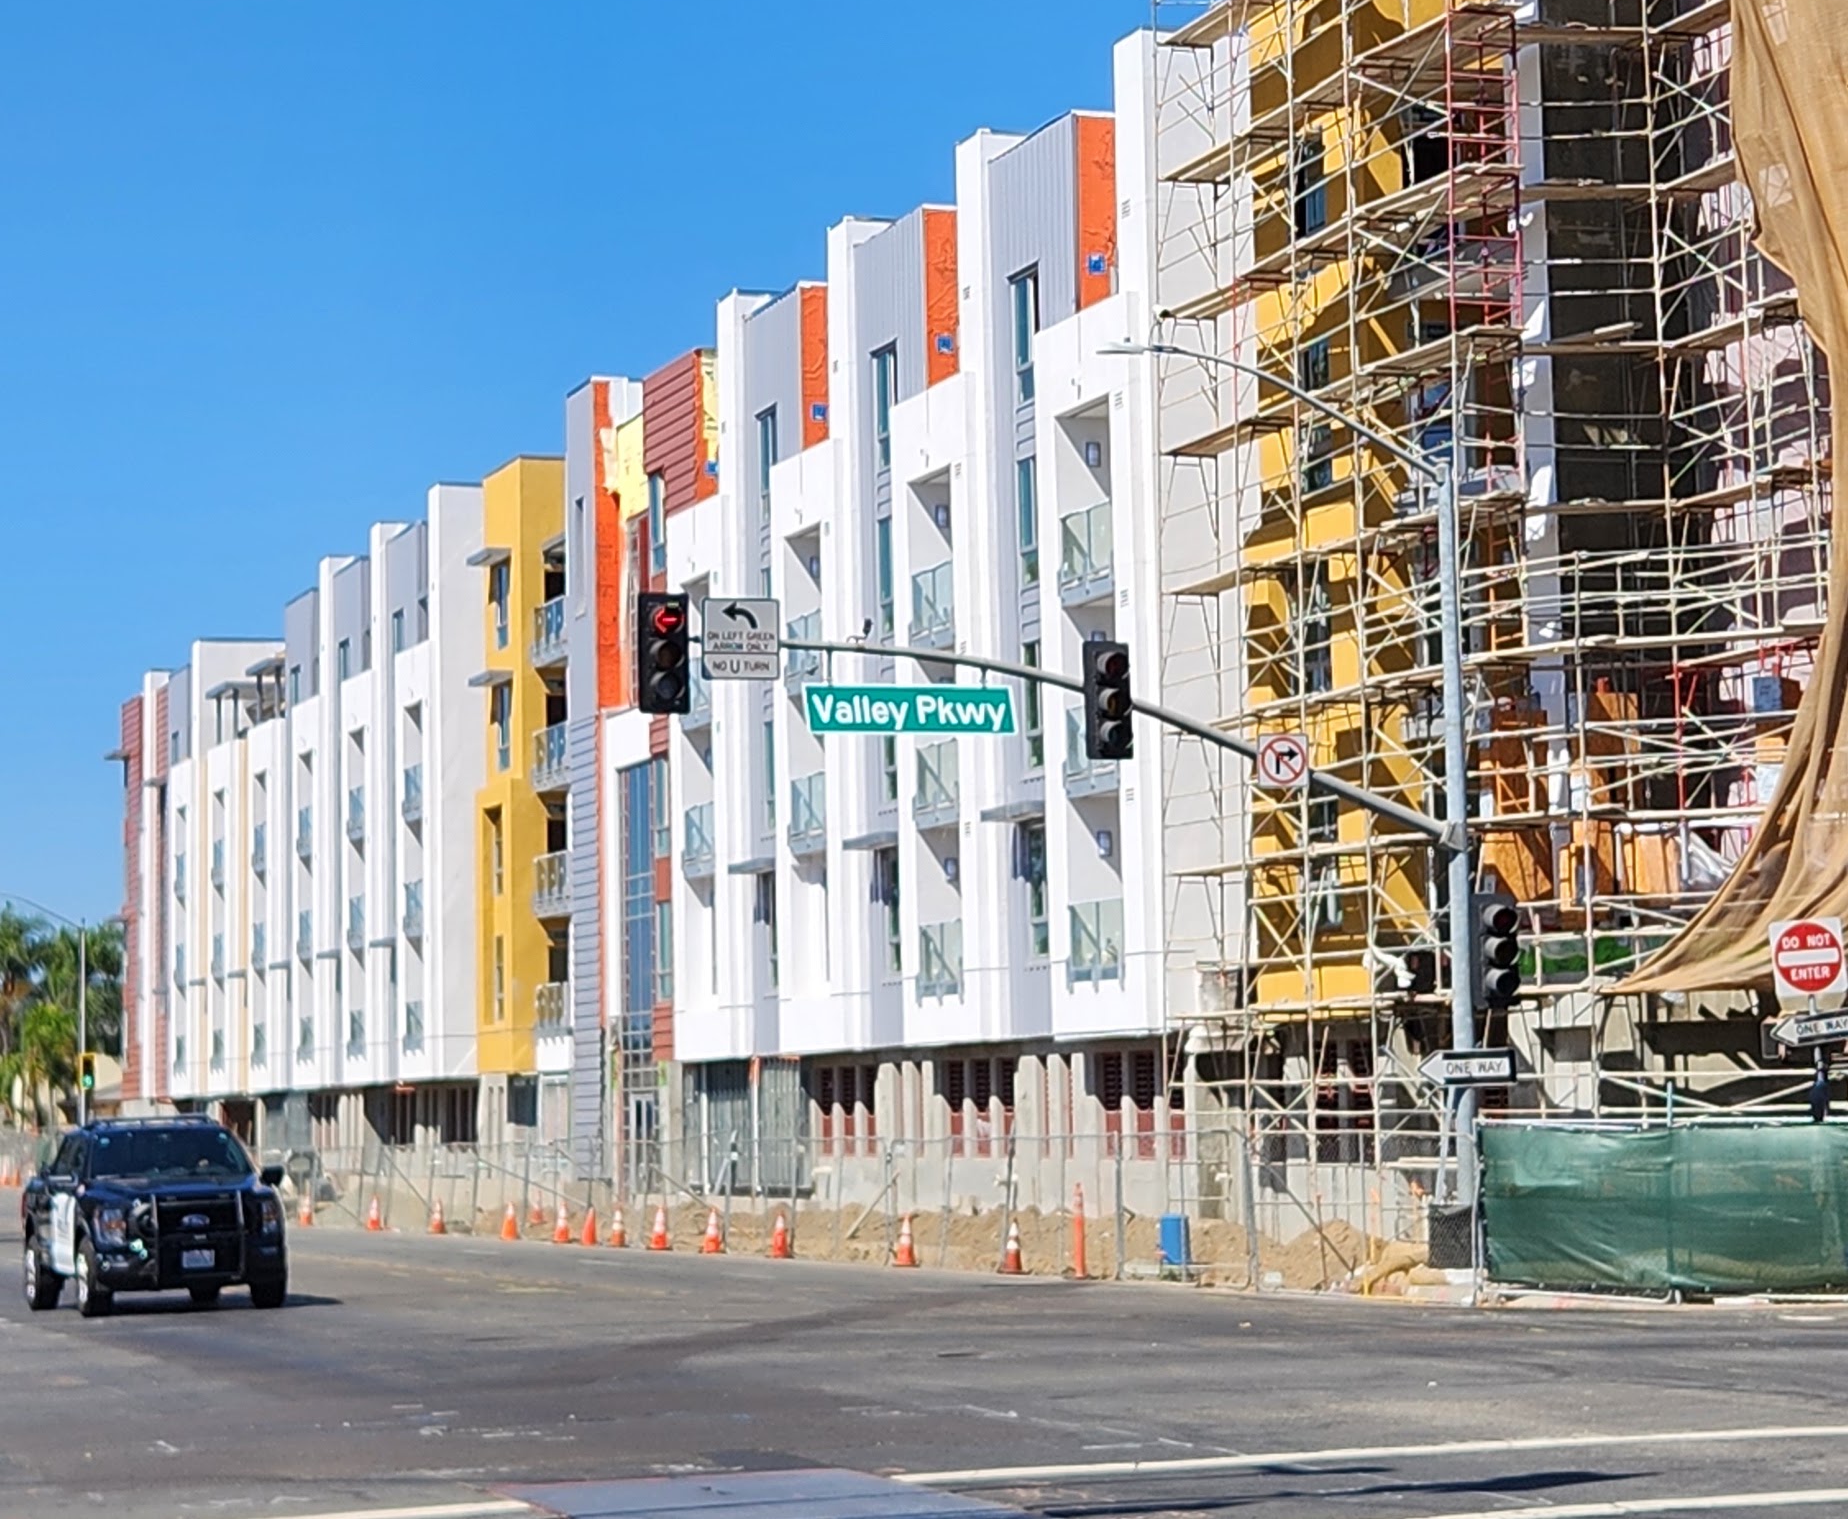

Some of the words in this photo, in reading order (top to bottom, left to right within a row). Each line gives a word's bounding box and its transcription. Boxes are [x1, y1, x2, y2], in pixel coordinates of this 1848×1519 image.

[707, 631, 719, 640] ON
[722, 631, 743, 640] LEFT
[746, 631, 775, 640] GREEN
[746, 642, 769, 651] ONLY
[712, 660, 727, 671] NO
[730, 659, 740, 674] U
[743, 661, 770, 671] TURN
[811, 693, 909, 731] Valley
[915, 694, 1006, 732] Pkwy
[1782, 936, 1799, 949] DO
[1806, 933, 1831, 947] NOT
[1790, 966, 1830, 981] ENTER
[1796, 1023, 1820, 1035] ONE
[1825, 1018, 1848, 1030] WAY
[1446, 1062, 1471, 1074] ONE
[1478, 1060, 1503, 1073] WAY
